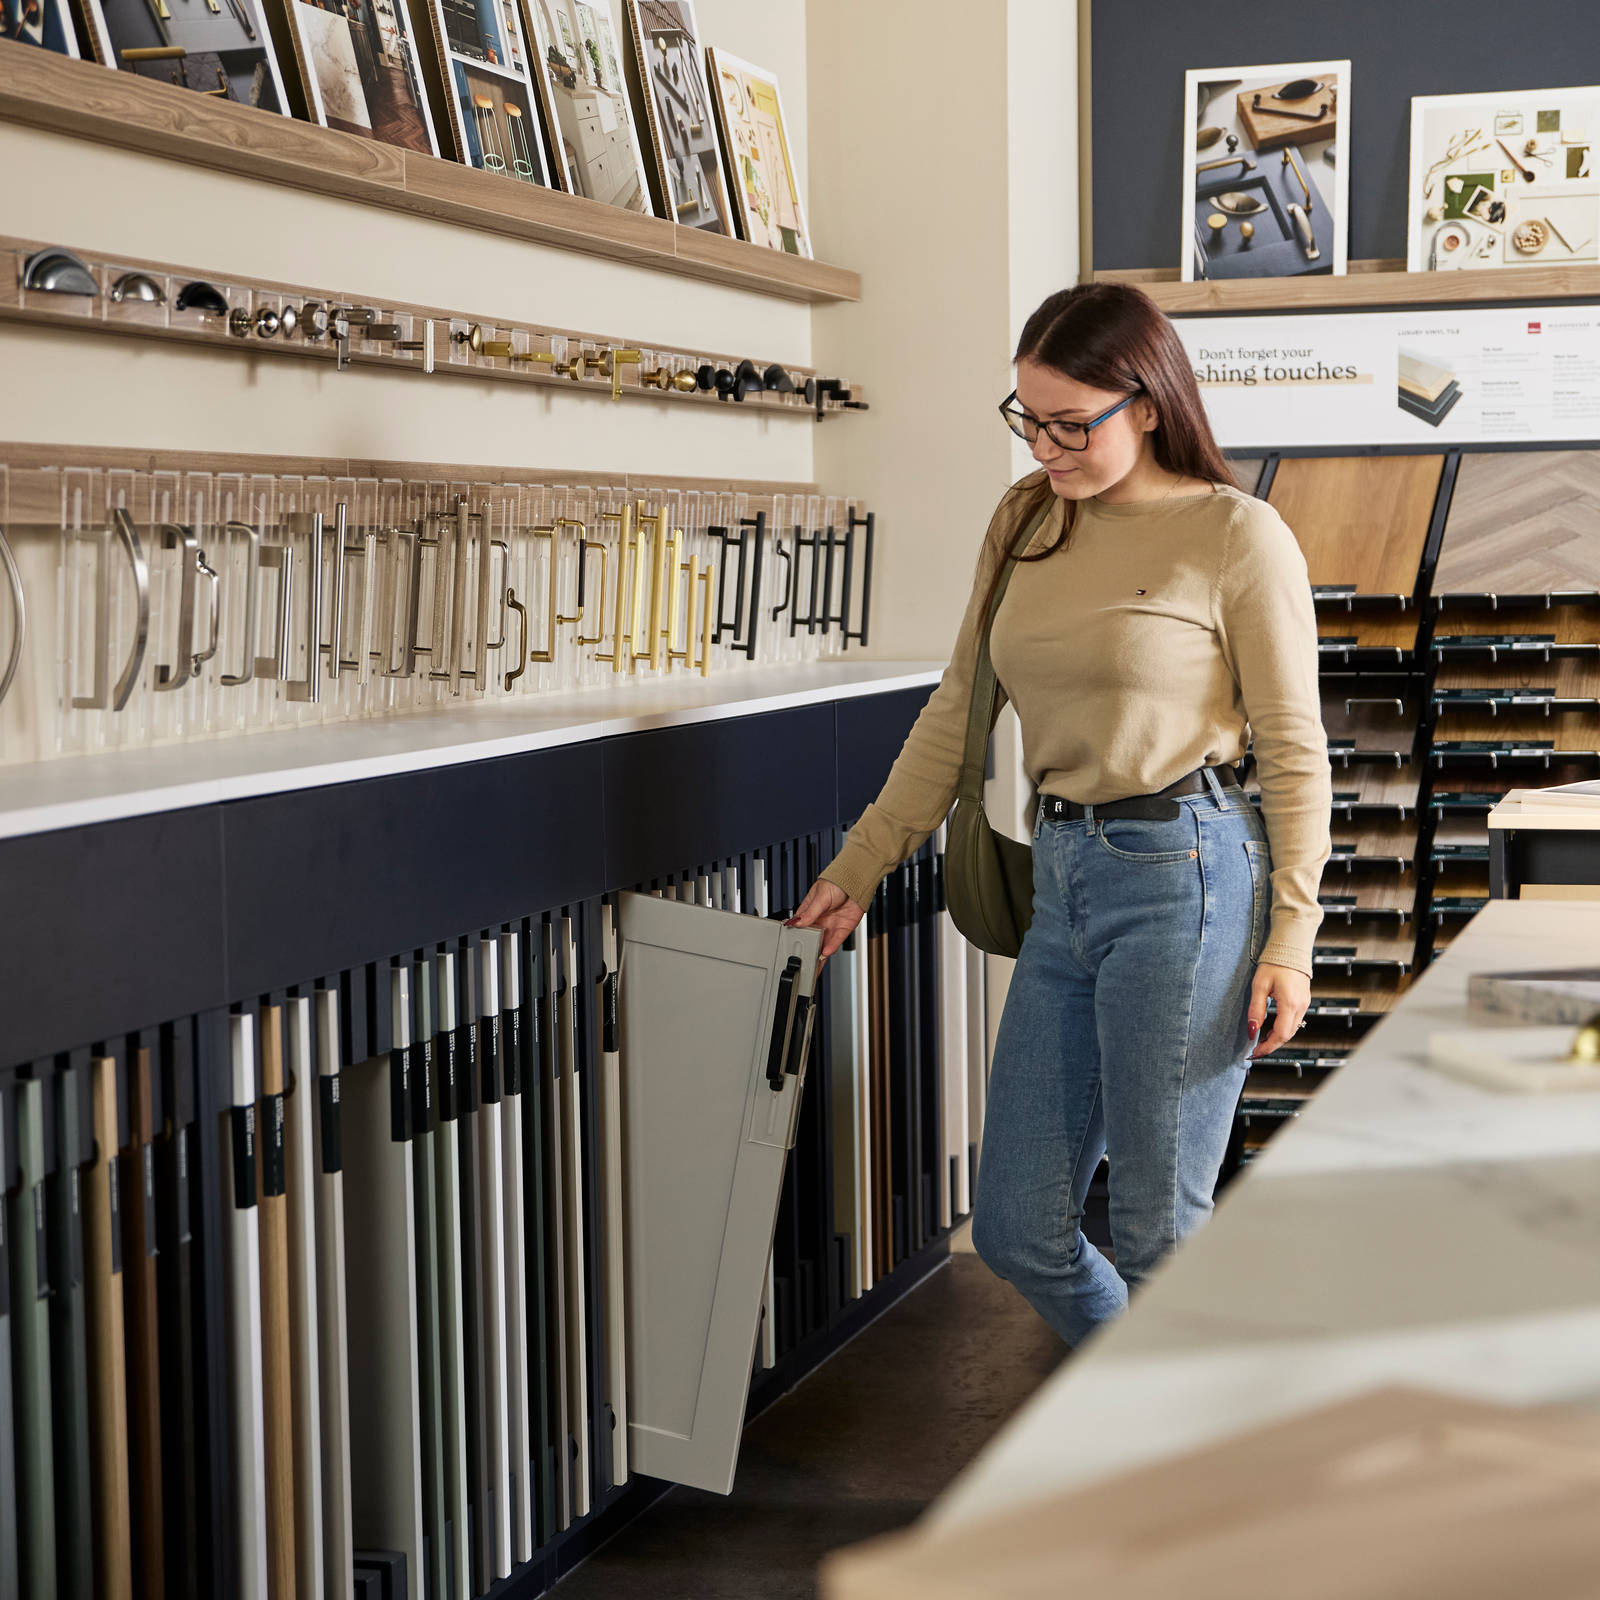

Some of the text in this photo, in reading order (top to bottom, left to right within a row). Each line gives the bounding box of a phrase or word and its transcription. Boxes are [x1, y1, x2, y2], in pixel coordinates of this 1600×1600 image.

[1199, 347, 1314, 361] Don't forget your
[1264, 361, 1358, 382] touches
